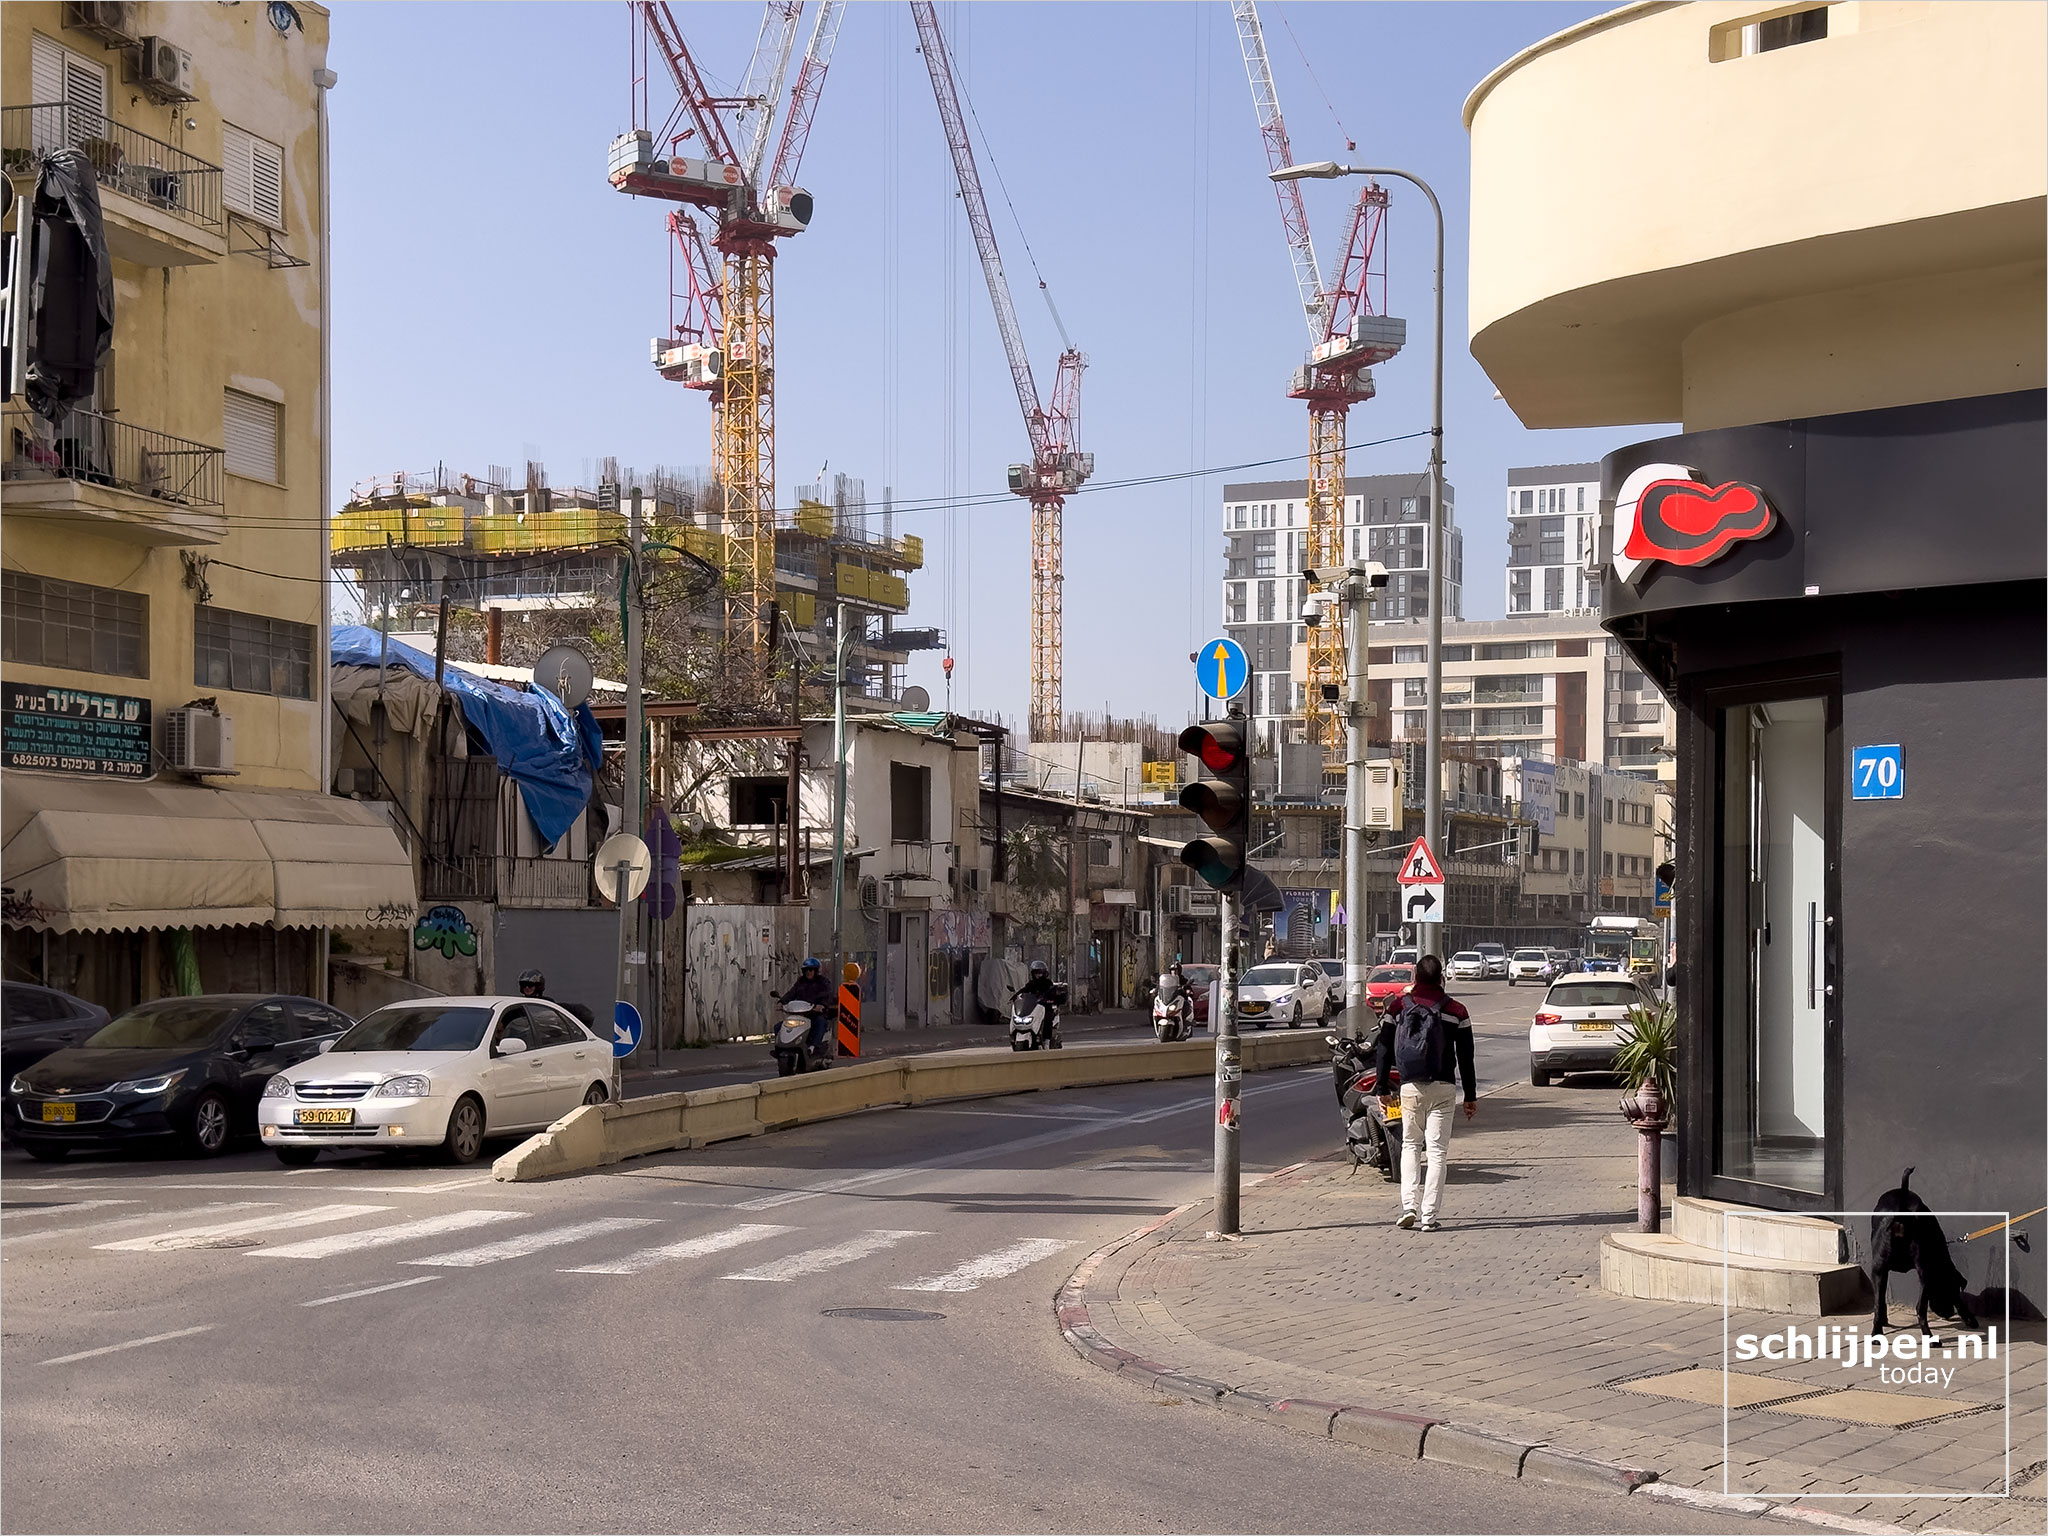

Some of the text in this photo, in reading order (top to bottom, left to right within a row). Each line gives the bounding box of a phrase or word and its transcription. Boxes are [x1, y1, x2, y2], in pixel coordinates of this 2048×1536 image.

[96, 721, 121, 734] ושיווק
[123, 724, 142, 736] יבוא
[108, 748, 124, 759] לכל
[12, 754, 143, 774] סלמה 72 טלפקס 6825073
[1859, 757, 1897, 787] 70
